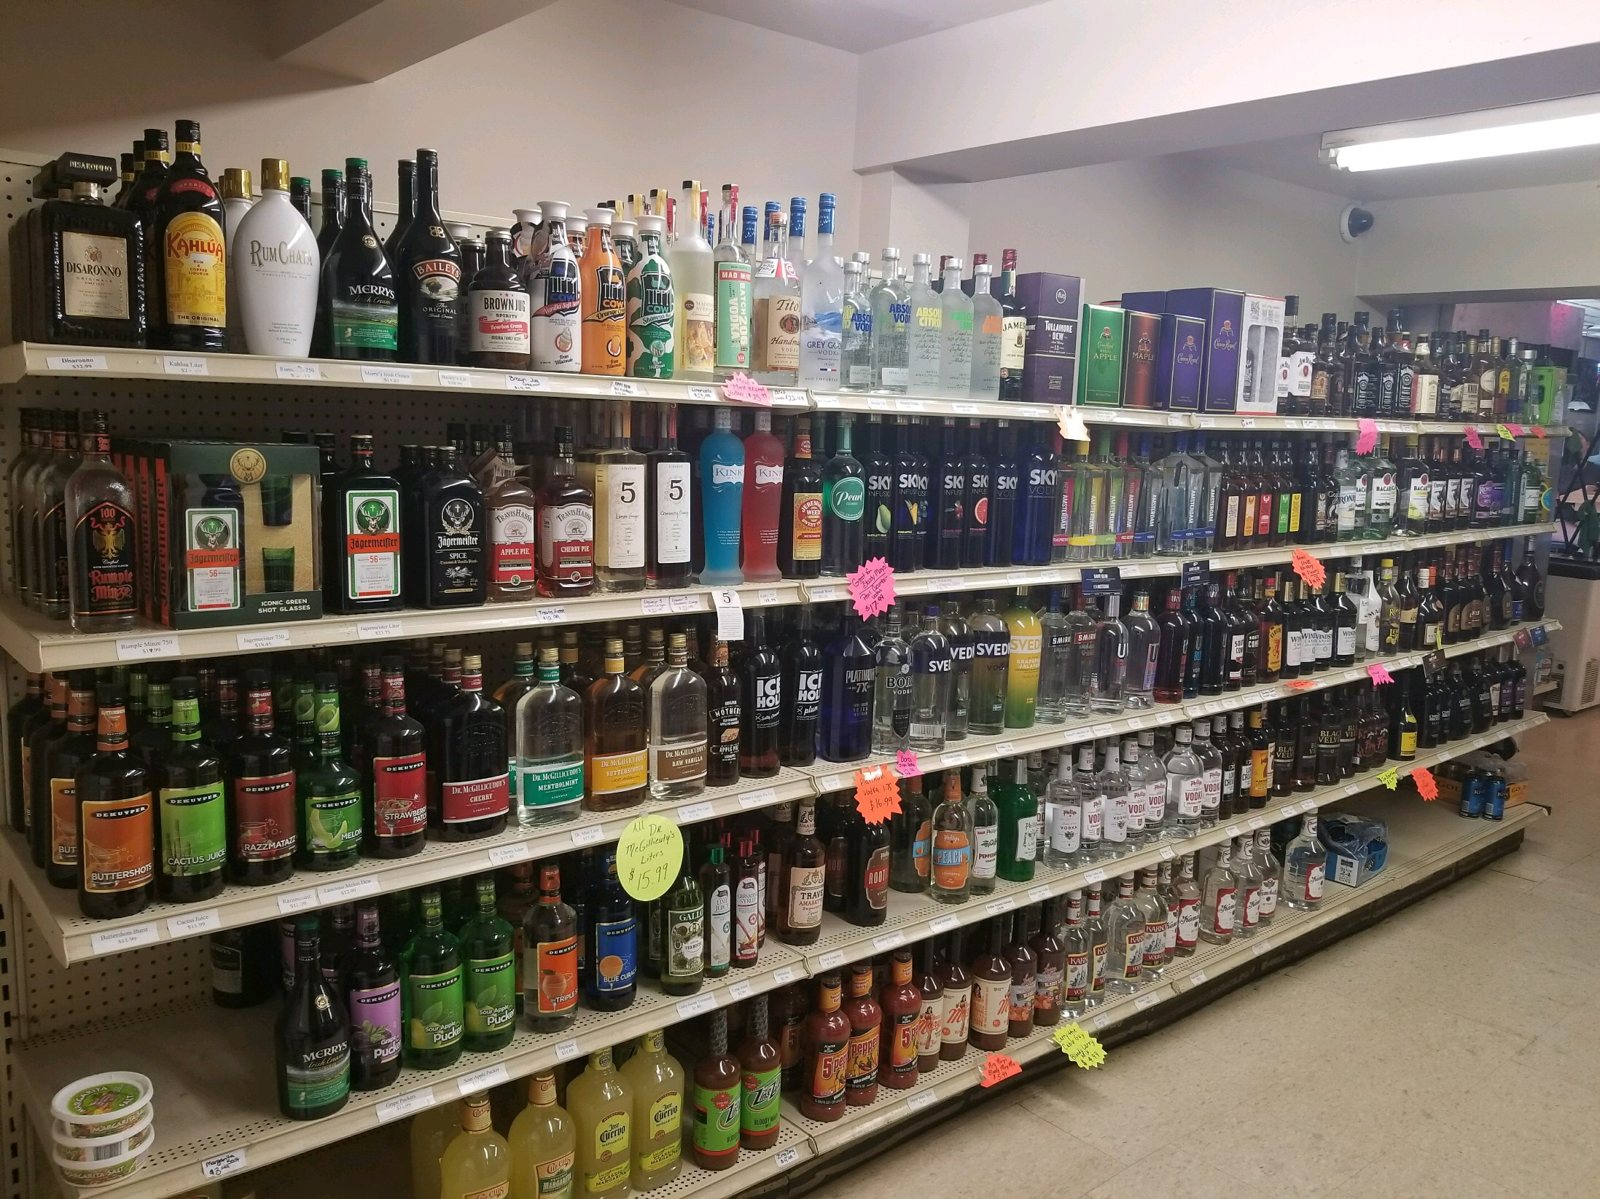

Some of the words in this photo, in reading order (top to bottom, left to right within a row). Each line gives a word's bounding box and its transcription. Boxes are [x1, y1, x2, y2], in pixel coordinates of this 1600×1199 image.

[167, 231, 224, 263] KAHLÚA
[66, 261, 121, 277] DISARONNO
[417, 262, 460, 278] BAILEYS
[484, 297, 514, 311] BROWN
[1045, 320, 1073, 333] TULLAMORE
[806, 341, 825, 349] GREY
[1093, 353, 1118, 361] APPLE
[621, 482, 635, 504] 5
[669, 479, 683, 500] 5
[449, 552, 467, 560] SPICE
[518, 547, 530, 555] PIE
[285, 598, 308, 606] GREEN
[722, 592, 731, 604] 5
[258, 606, 277, 614] SHOT
[280, 604, 311, 612] GLASSES
[672, 759, 683, 767] RAW
[470, 794, 493, 803] CHERRY
[244, 836, 296, 851] RAZZMATAZZ
[167, 854, 205, 866] CACTUS
[206, 849, 226, 864] JUICE
[91, 863, 152, 881] BUTTERSHOTS
[603, 975, 619, 983] BLUE
[901, 1029, 910, 1047] 5
[302, 1041, 348, 1063] MERRYS
[823, 1056, 832, 1079] 5
[654, 1106, 678, 1123] Cuervo
[600, 1126, 626, 1143] Cuervo
